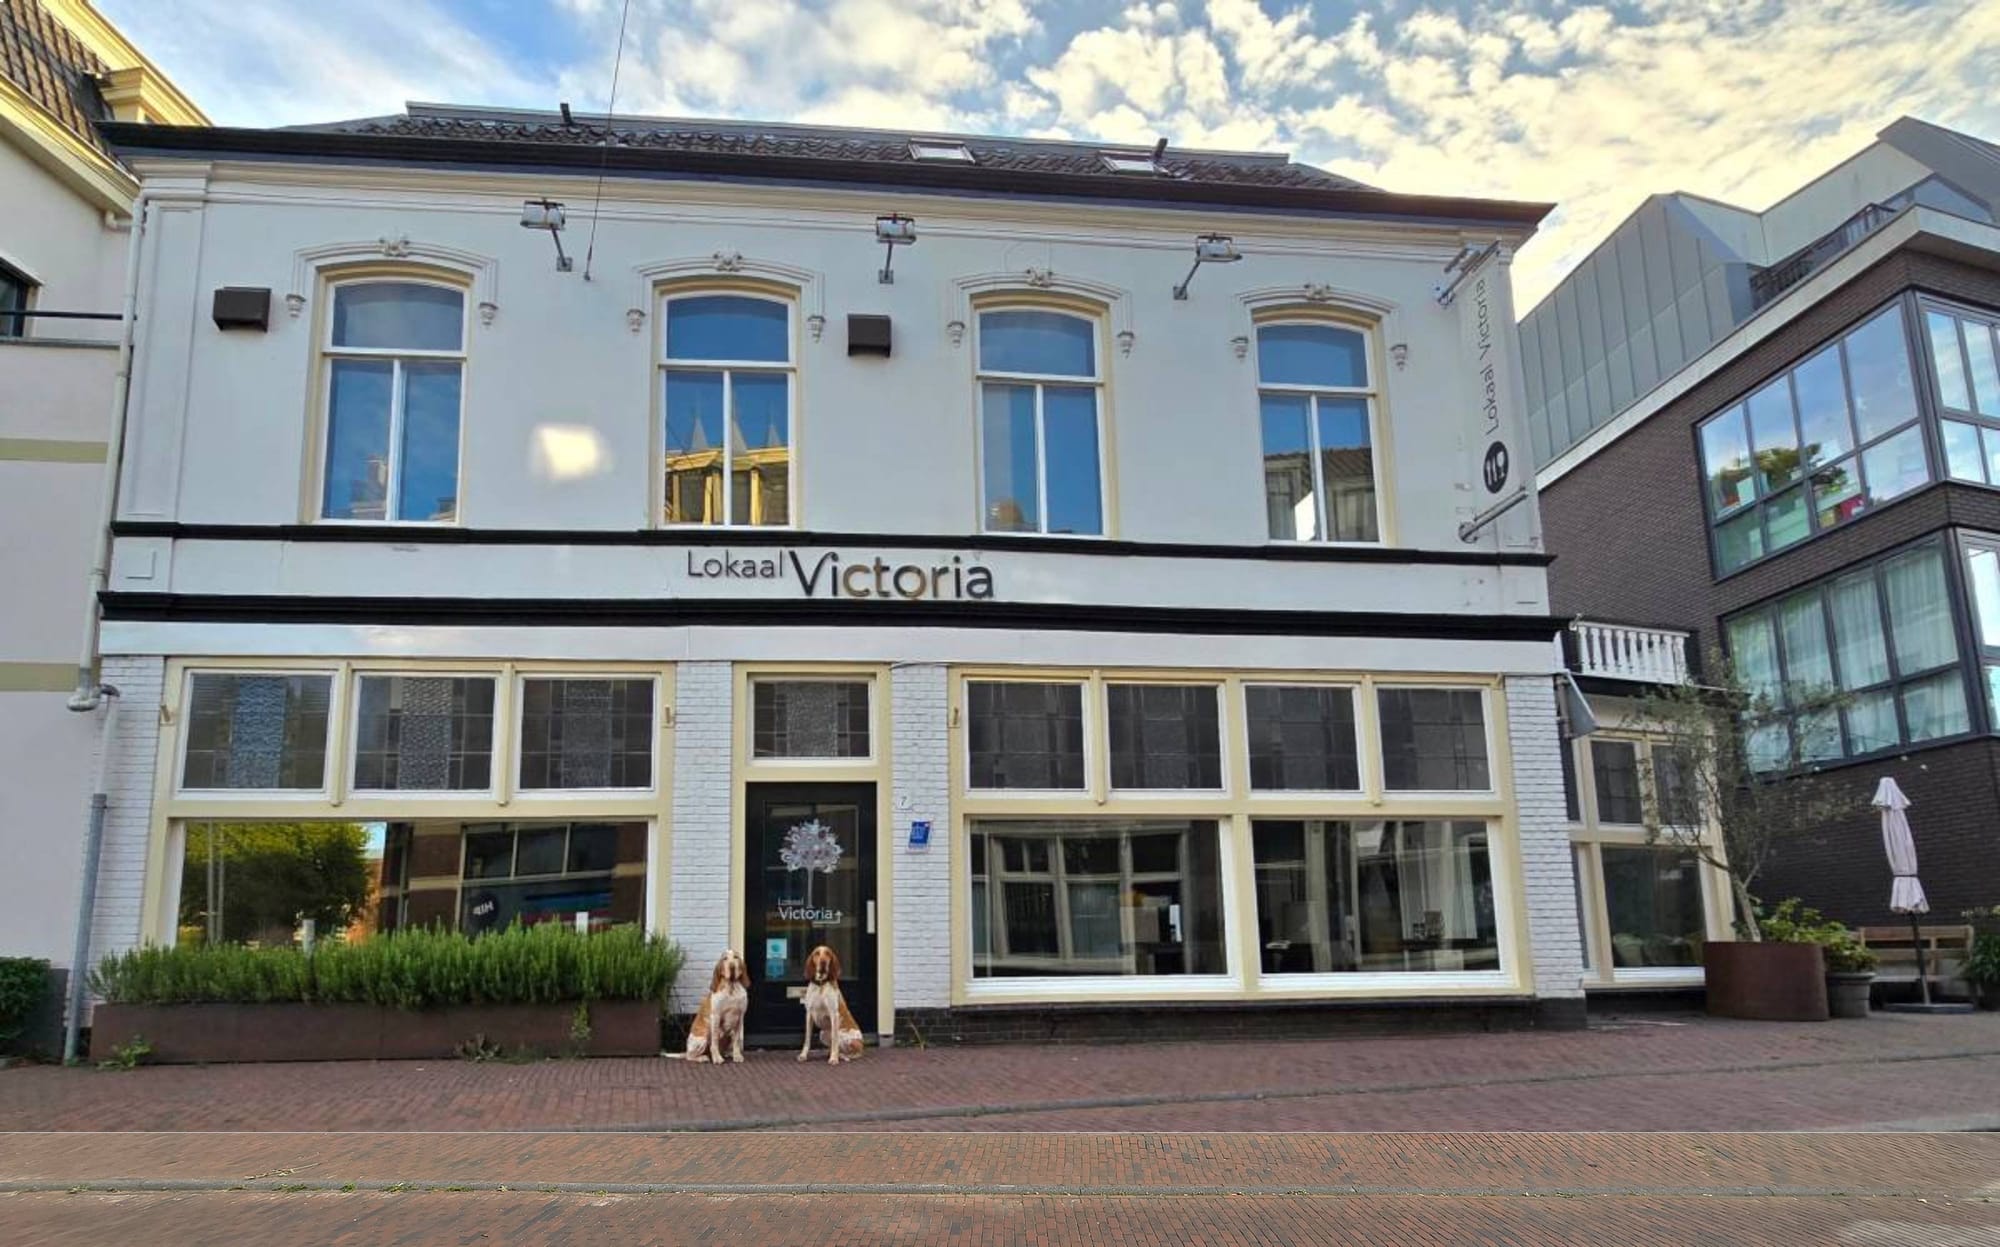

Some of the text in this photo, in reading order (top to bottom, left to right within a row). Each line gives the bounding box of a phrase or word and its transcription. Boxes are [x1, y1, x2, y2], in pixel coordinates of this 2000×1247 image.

[1475, 278, 1499, 436] Lokaal Victoria
[687, 549, 994, 599] Lokaal Victoria
[778, 906, 833, 920] Victoria
